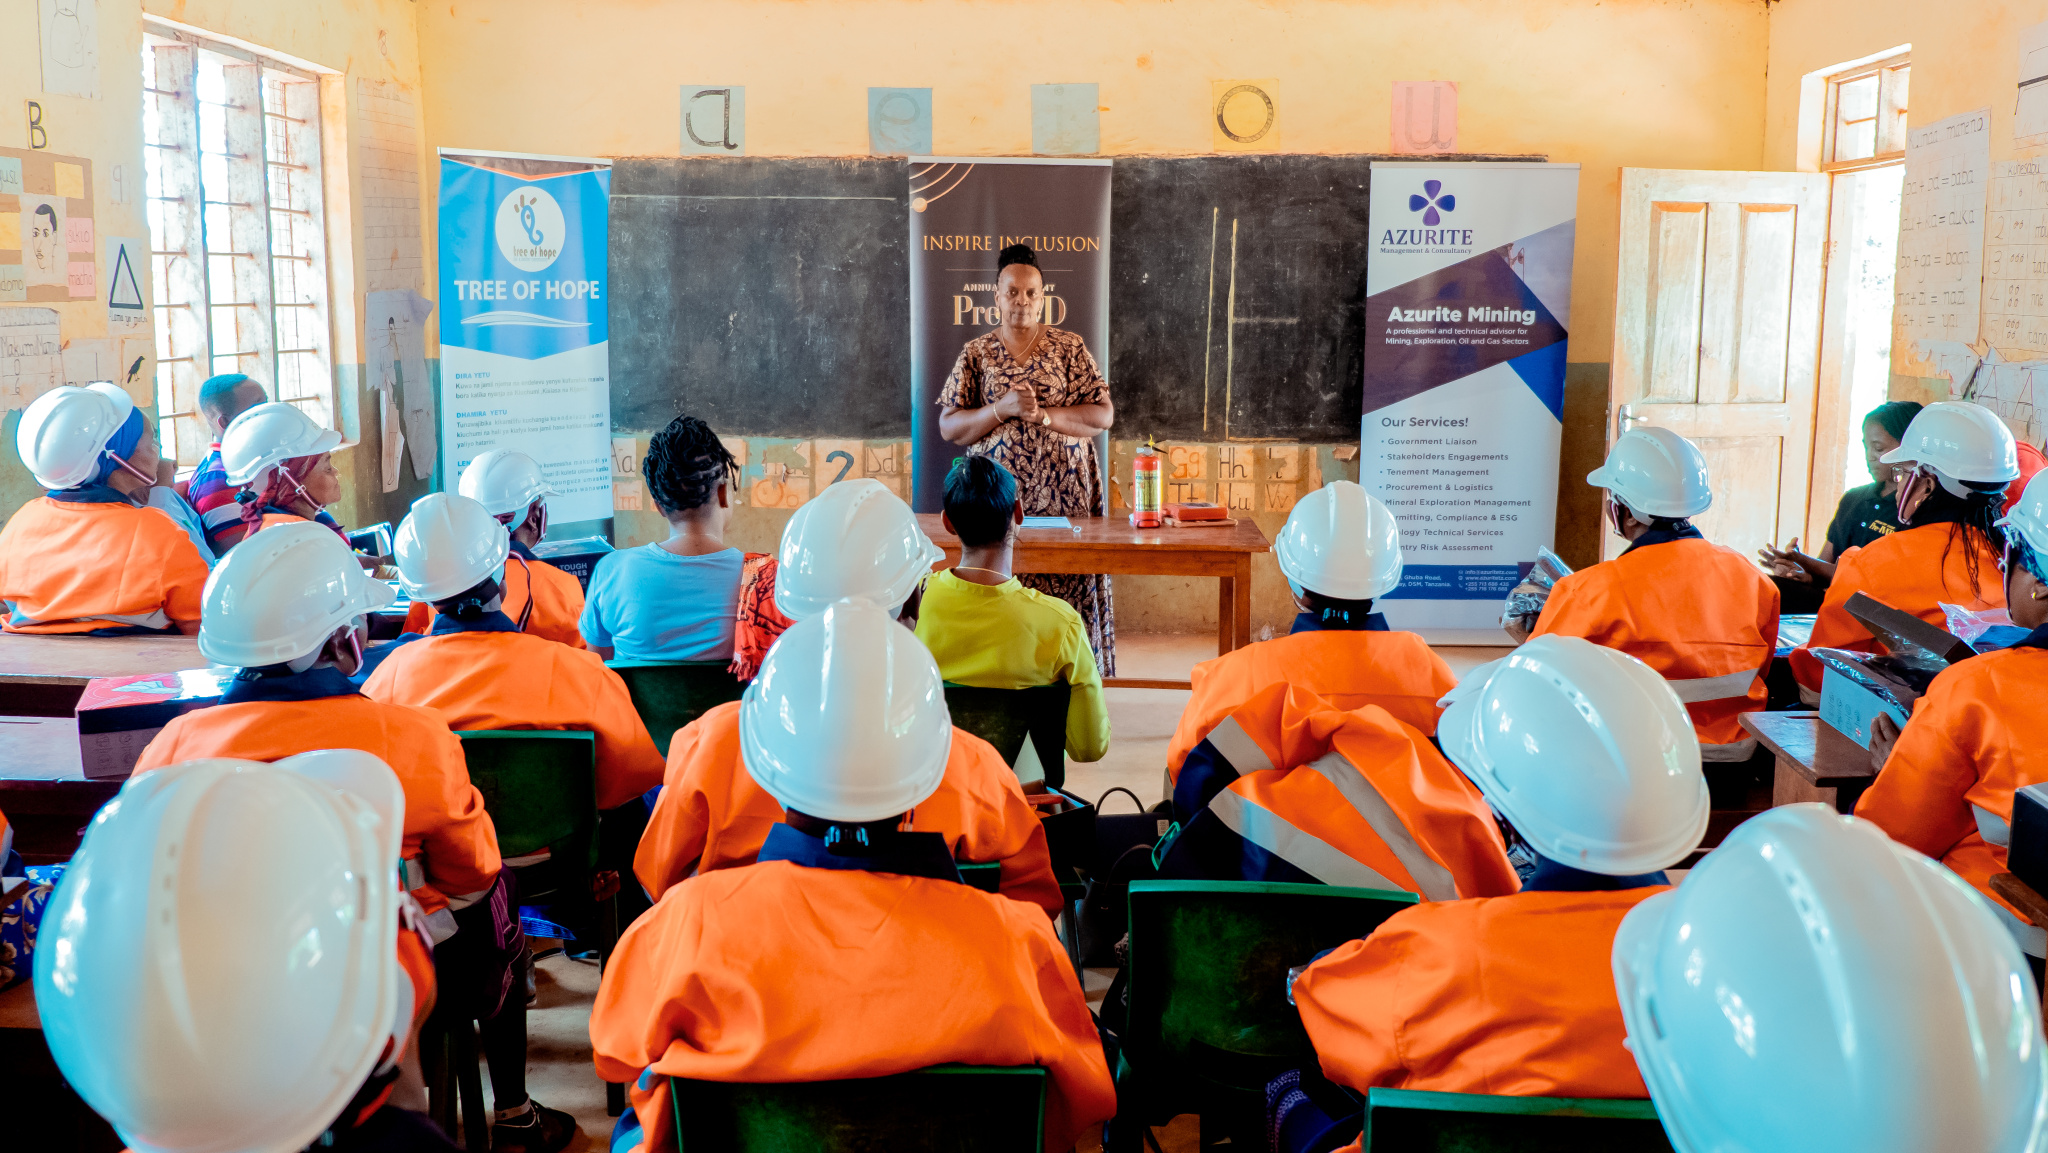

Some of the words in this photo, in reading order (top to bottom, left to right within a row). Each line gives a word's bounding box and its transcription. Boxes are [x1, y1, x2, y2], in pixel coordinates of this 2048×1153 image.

[685, 88, 738, 150] a
[873, 91, 922, 149] e
[1217, 85, 1274, 143] o
[1405, 86, 1453, 150] u
[28, 101, 47, 149] B
[924, 235, 992, 251] INSPIRE
[1381, 229, 1473, 245] AZURITE
[513, 246, 528, 257] tree
[530, 246, 537, 257] of
[539, 246, 557, 260] hope
[1431, 247, 1472, 255] Consultancy
[454, 280, 507, 300] TREE
[512, 280, 540, 300] OF
[546, 280, 600, 300] HOPE
[963, 283, 998, 292] ANNUA
[1387, 306, 1462, 322] Azurite
[1467, 306, 1536, 326] Mining
[1393, 328, 1437, 336] professional
[1385, 338, 1412, 346] Mining,
[1413, 338, 1456, 346] Exploration,
[456, 410, 486, 419] DHAMIRA
[1381, 417, 1405, 427] Our
[1409, 416, 1469, 427] Services!
[1219, 447, 1248, 479] Hh
[1387, 453, 1445, 461] Stakeholders
[1448, 453, 1509, 461] Engagements
[826, 450, 854, 484] 2
[1432, 469, 1489, 477] Management
[1454, 484, 1493, 492] Logistics
[1419, 499, 1471, 507] Exploration
[1473, 499, 1531, 507] Management
[1436, 514, 1488, 522] Compliance
[1399, 529, 1420, 537] logy
